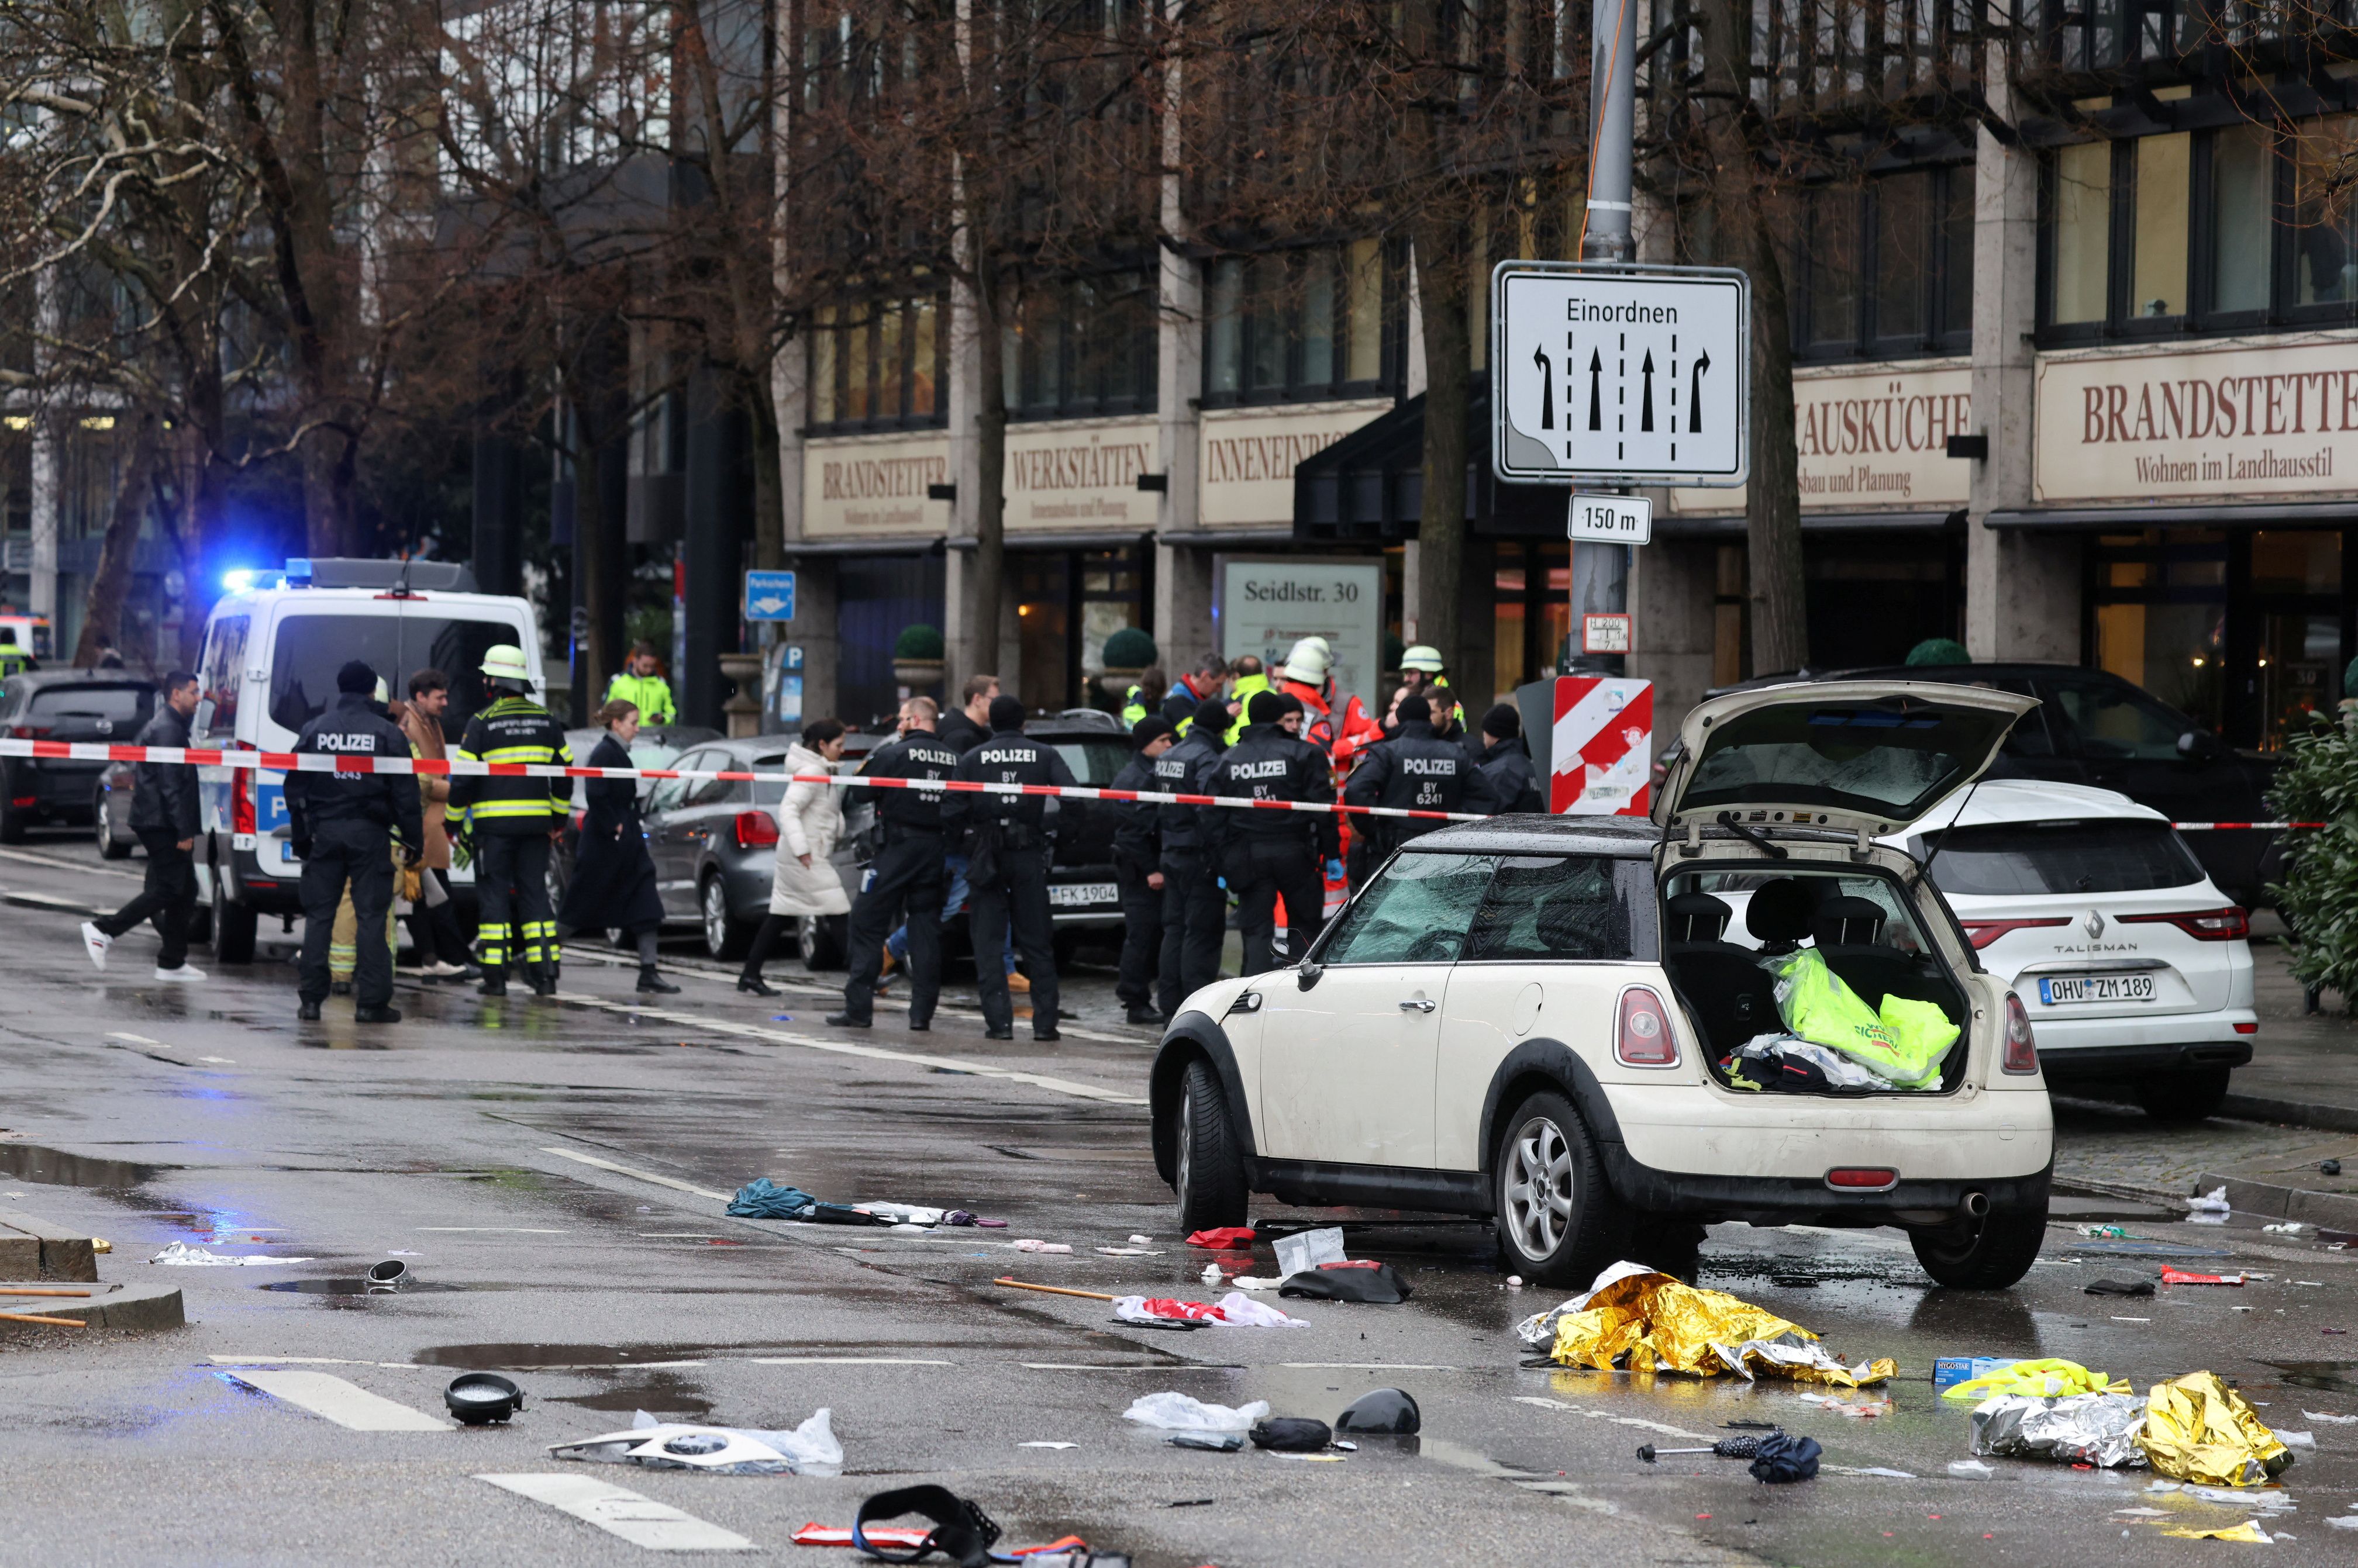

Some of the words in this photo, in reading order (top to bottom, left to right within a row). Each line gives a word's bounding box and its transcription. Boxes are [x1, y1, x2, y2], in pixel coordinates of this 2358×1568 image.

[1568, 298, 1677, 323] Einordnen
[2081, 369, 2358, 444] BRANDSTETTE
[1012, 435, 1150, 491] WERKSTÄTTEN
[2135, 454, 2197, 483] Wohnen
[2202, 453, 2222, 481] im
[2228, 447, 2333, 480] Landhausstil
[823, 455, 946, 500] BRANDSTETTER
[1829, 465, 1854, 493] und
[1858, 465, 1911, 497] Planung
[1585, 507, 1614, 529] 150
[1621, 515, 1635, 530] m
[1244, 579, 1326, 602] Seidlstr.
[1334, 582, 1359, 602] 30
[1590, 618, 1596, 627] H
[1603, 618, 1620, 627] 200
[789, 647, 802, 668] P
[317, 734, 375, 751] POLIZEI
[908, 748, 957, 766] POLIZEI
[981, 749, 1036, 764] POLIZEI
[926, 769, 940, 780] BY
[1155, 760, 1185, 779] POLIZEI
[1230, 760, 1287, 780] POLIZEI
[1404, 758, 1456, 775] POLIZEI
[1002, 771, 1017, 783] BY
[1253, 784, 1268, 797] BY
[1423, 782, 1437, 793] BY
[1416, 793, 1442, 805] 6241
[1082, 886, 1116, 901] 1904
[2054, 943, 2138, 953] TALISMAN
[2052, 980, 2083, 1000] OHV
[2096, 979, 2119, 998] ZM
[2122, 978, 2153, 997] 189
